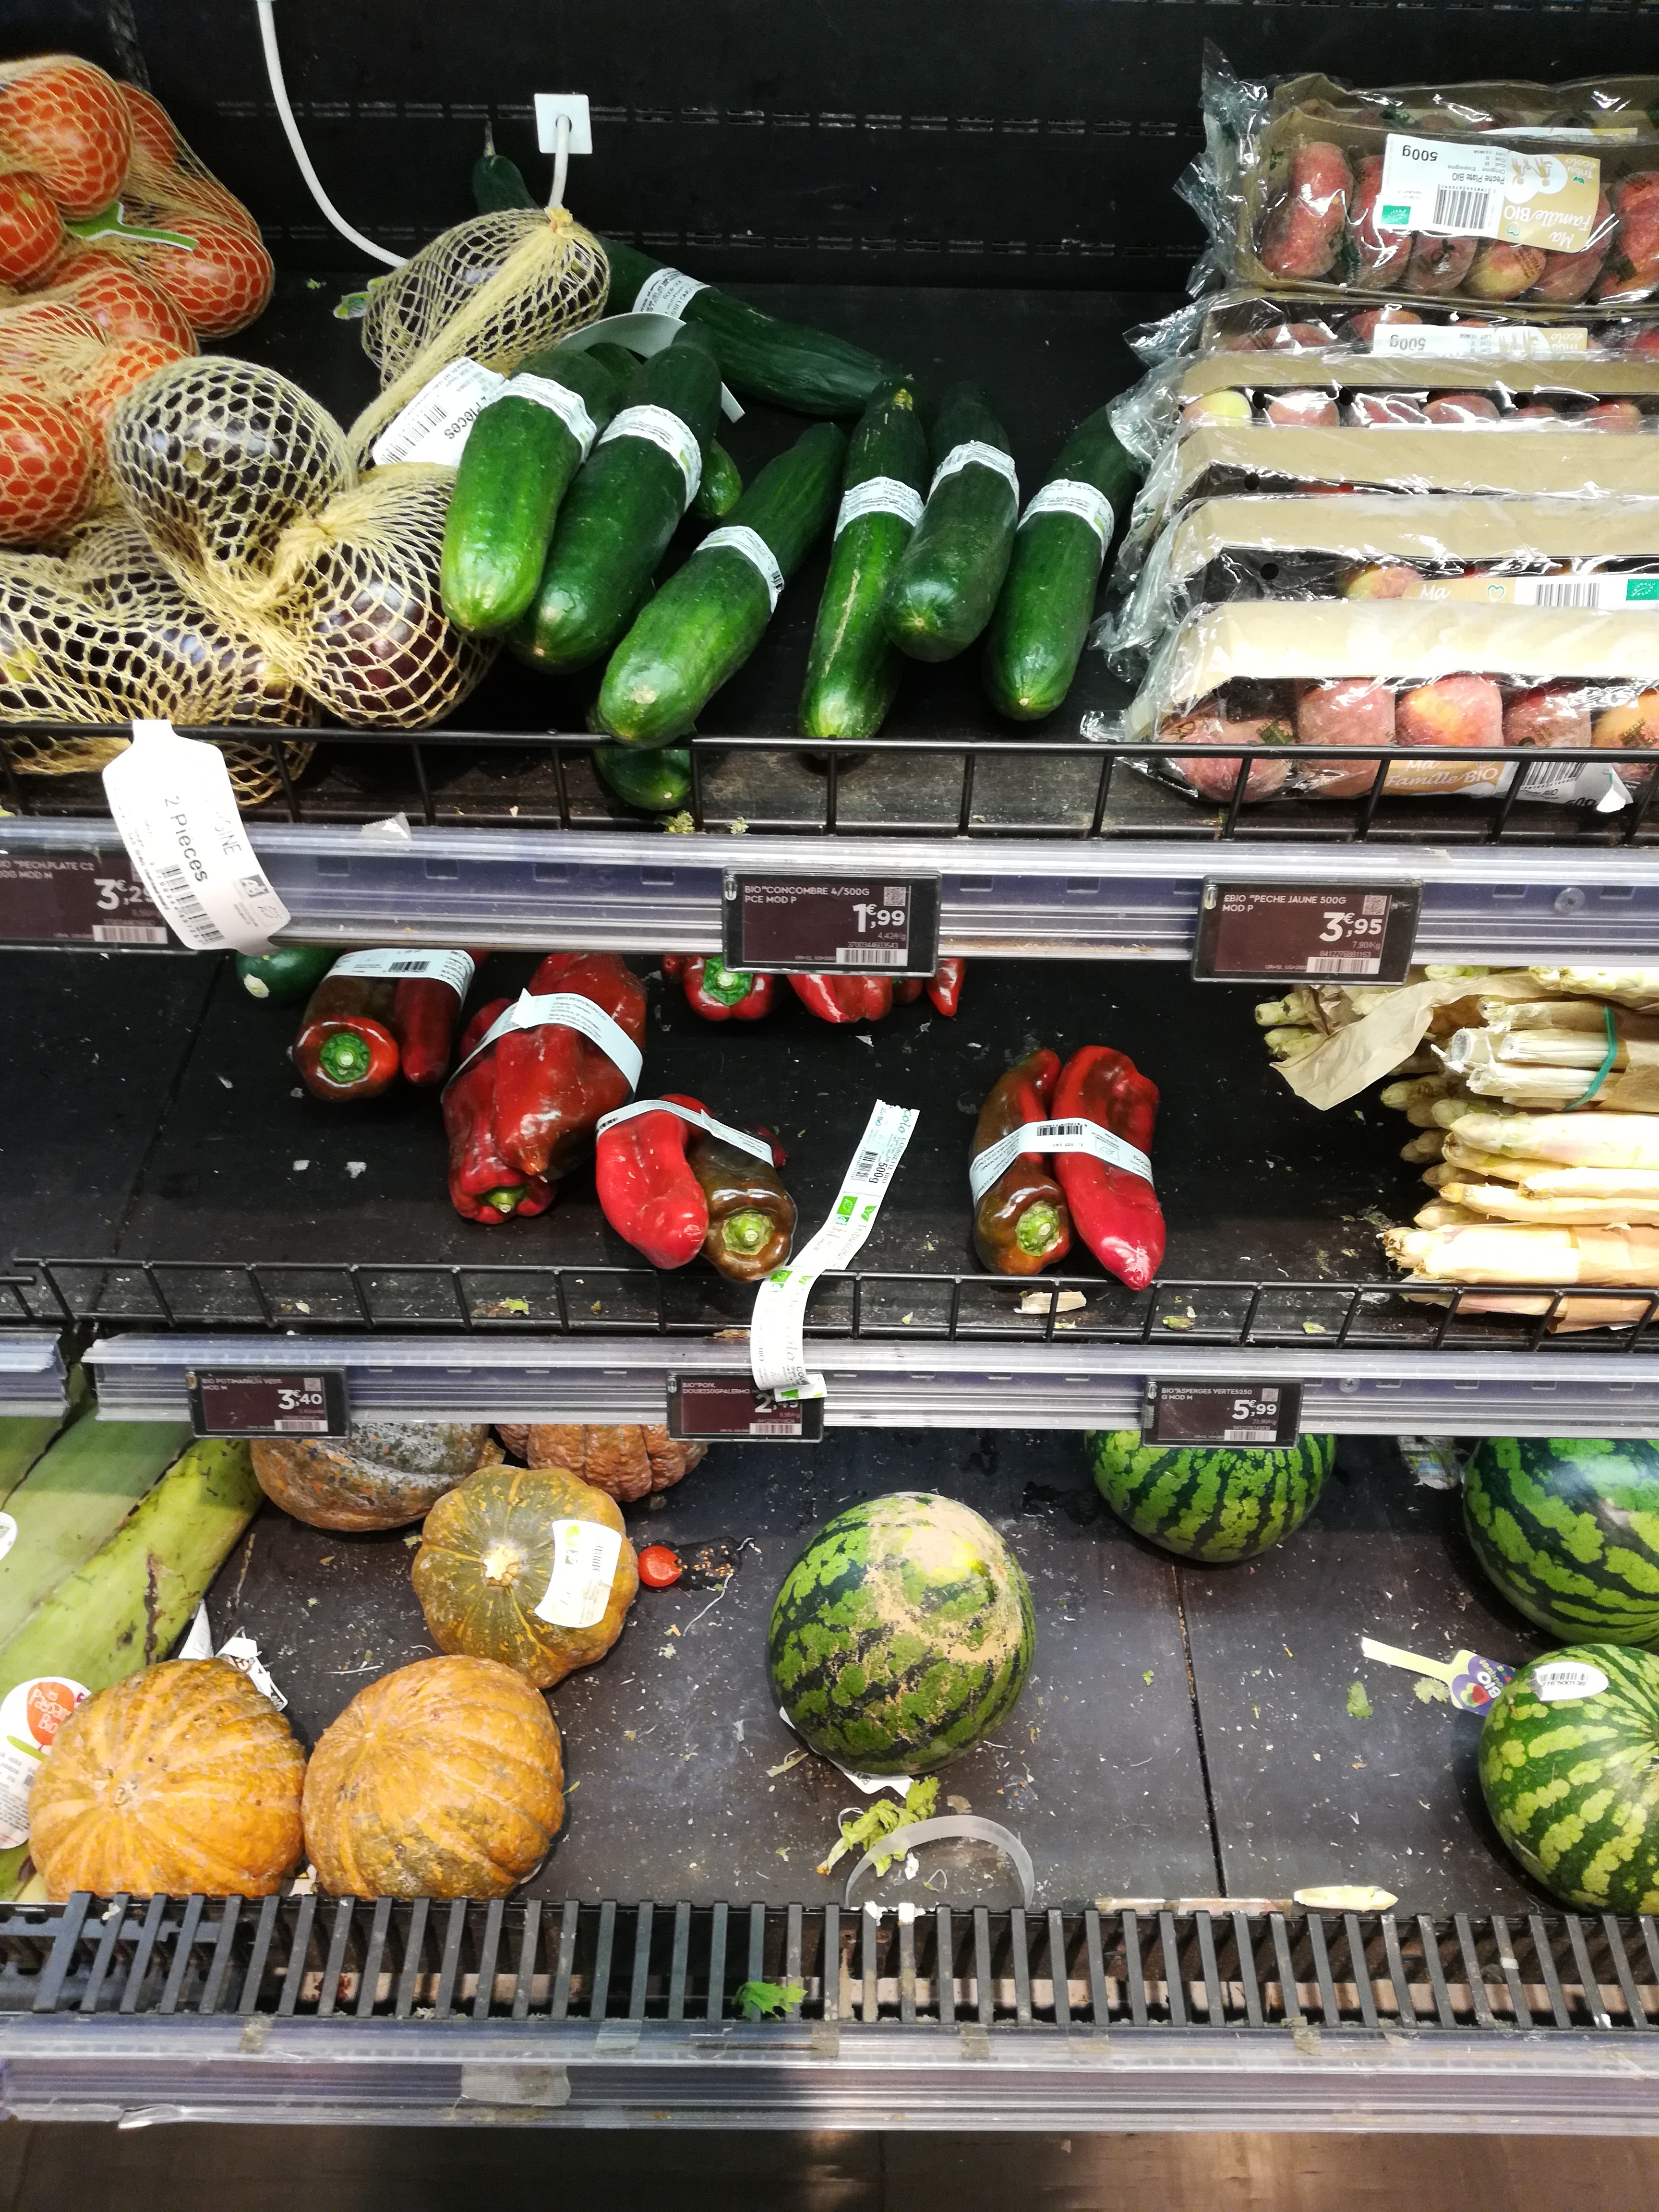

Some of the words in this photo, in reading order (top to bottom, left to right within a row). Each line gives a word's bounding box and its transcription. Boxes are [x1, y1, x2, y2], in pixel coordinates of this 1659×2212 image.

[1402, 145, 1439, 161] 500g
[1452, 172, 1465, 181] BIO
[1567, 166, 1593, 179] Tribu
[1504, 205, 1531, 222] BIO
[1531, 209, 1592, 231] Famille
[1548, 231, 1575, 249] Ma
[1389, 334, 1426, 351] 500g
[1420, 584, 1452, 601] Ma
[1385, 770, 1464, 787] Famille
[1464, 768, 1499, 783] BIO
[164, 796, 180, 807] 2
[745, 895, 764, 903] PCE
[766, 896, 789, 904] MOD
[830, 887, 870, 897] 4/500G
[1287, 895, 1318, 904] JAUNE
[1320, 896, 1346, 904] 500G
[1222, 904, 1246, 912] MOD
[898, 1109, 912, 1133] colo
[868, 1162, 888, 1184] 500g
[1477, 1671, 1502, 1698] BIO
